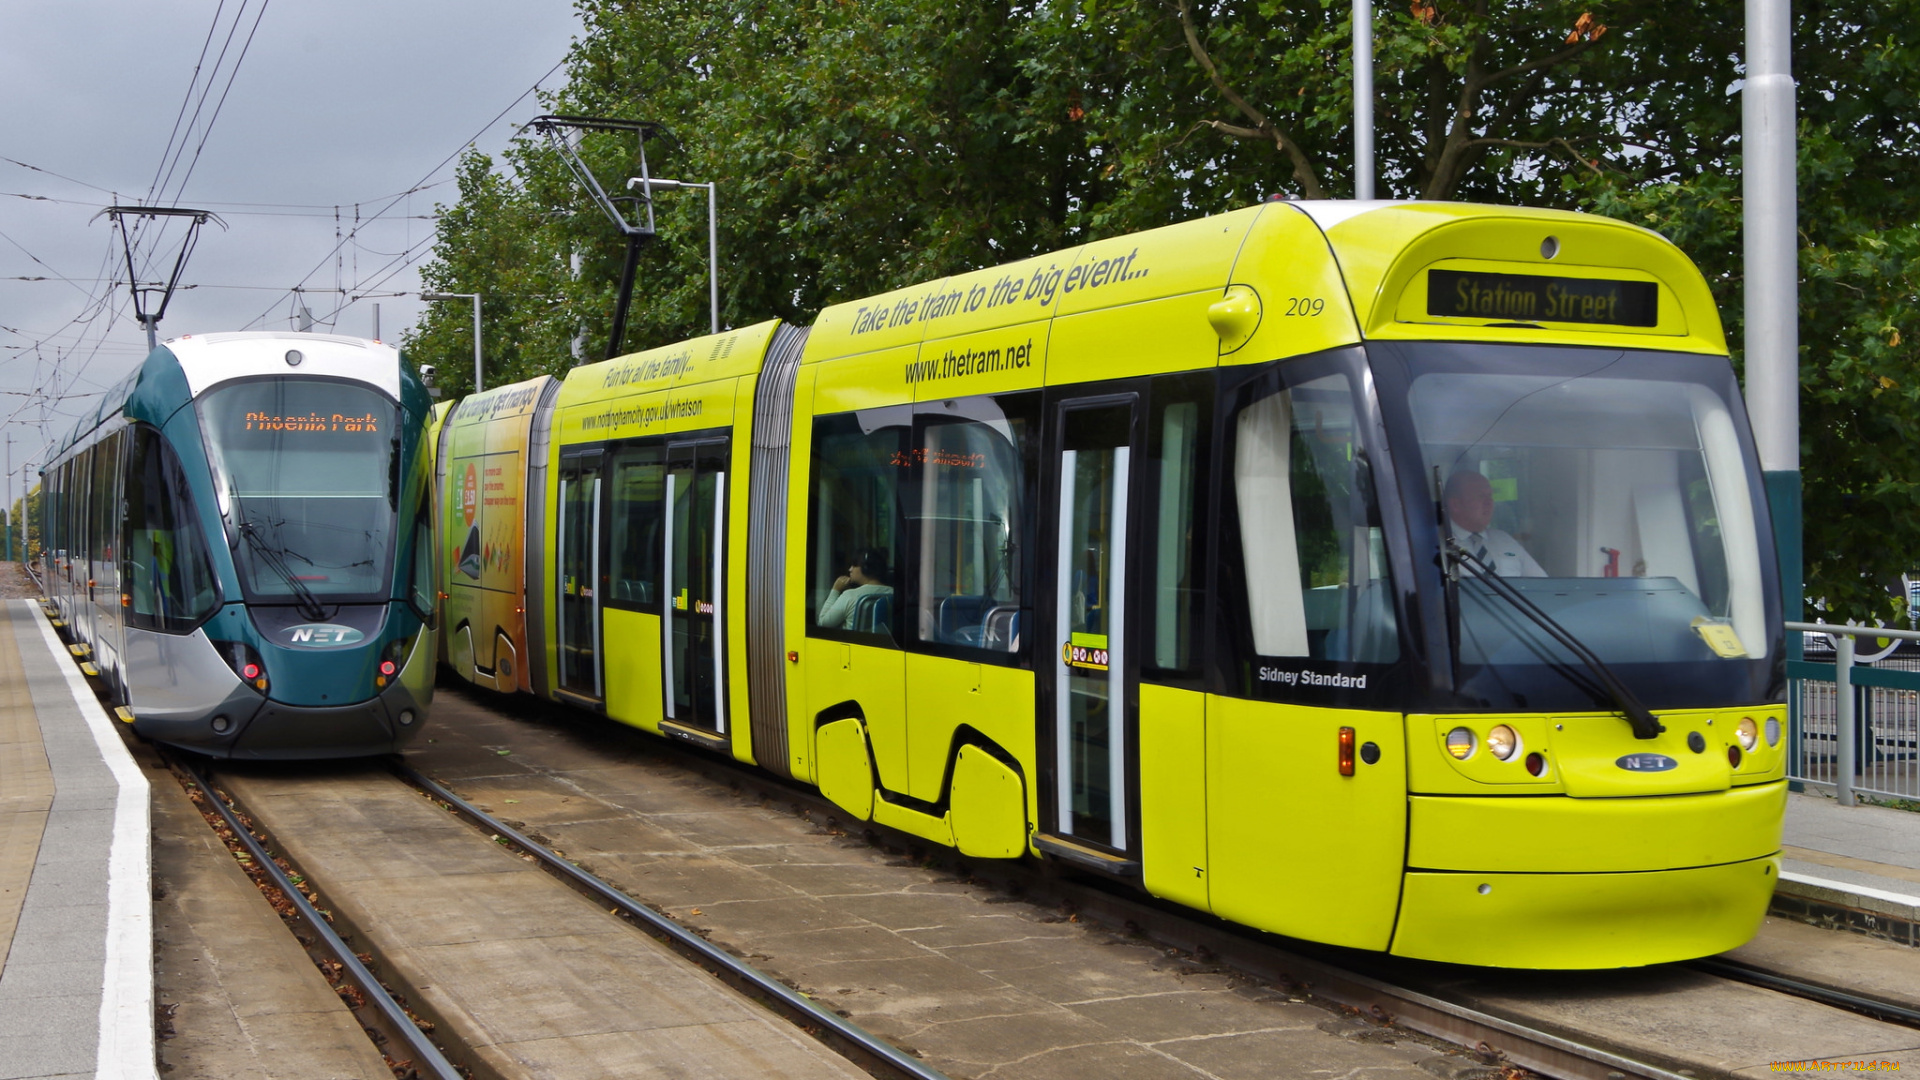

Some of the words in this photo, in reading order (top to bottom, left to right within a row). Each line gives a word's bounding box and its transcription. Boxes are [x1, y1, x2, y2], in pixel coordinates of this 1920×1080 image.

[850, 306, 889, 336] Take
[888, 296, 919, 328] the
[918, 288, 963, 323] tram
[962, 282, 986, 313] to
[986, 274, 1024, 309] the
[1023, 263, 1064, 307] big
[1063, 247, 1149, 294] event...
[1455, 276, 1537, 317] Station
[1544, 281, 1618, 320] Street
[1284, 297, 1325, 318] 209
[603, 368, 620, 388] Fun
[619, 364, 633, 385] for
[632, 361, 645, 382] all
[645, 359, 660, 380] the
[904, 338, 1033, 385] www.thetram.net
[504, 386, 538, 414] mango
[245, 411, 328, 432] Phoenix
[331, 412, 378, 433] Park
[582, 399, 702, 430] www.nottinghamcity.gov.uk/whatson
[290, 628, 351, 643] NET
[1258, 666, 1299, 687] Sidney
[1300, 669, 1367, 689] Standard
[1626, 756, 1667, 770] NET
